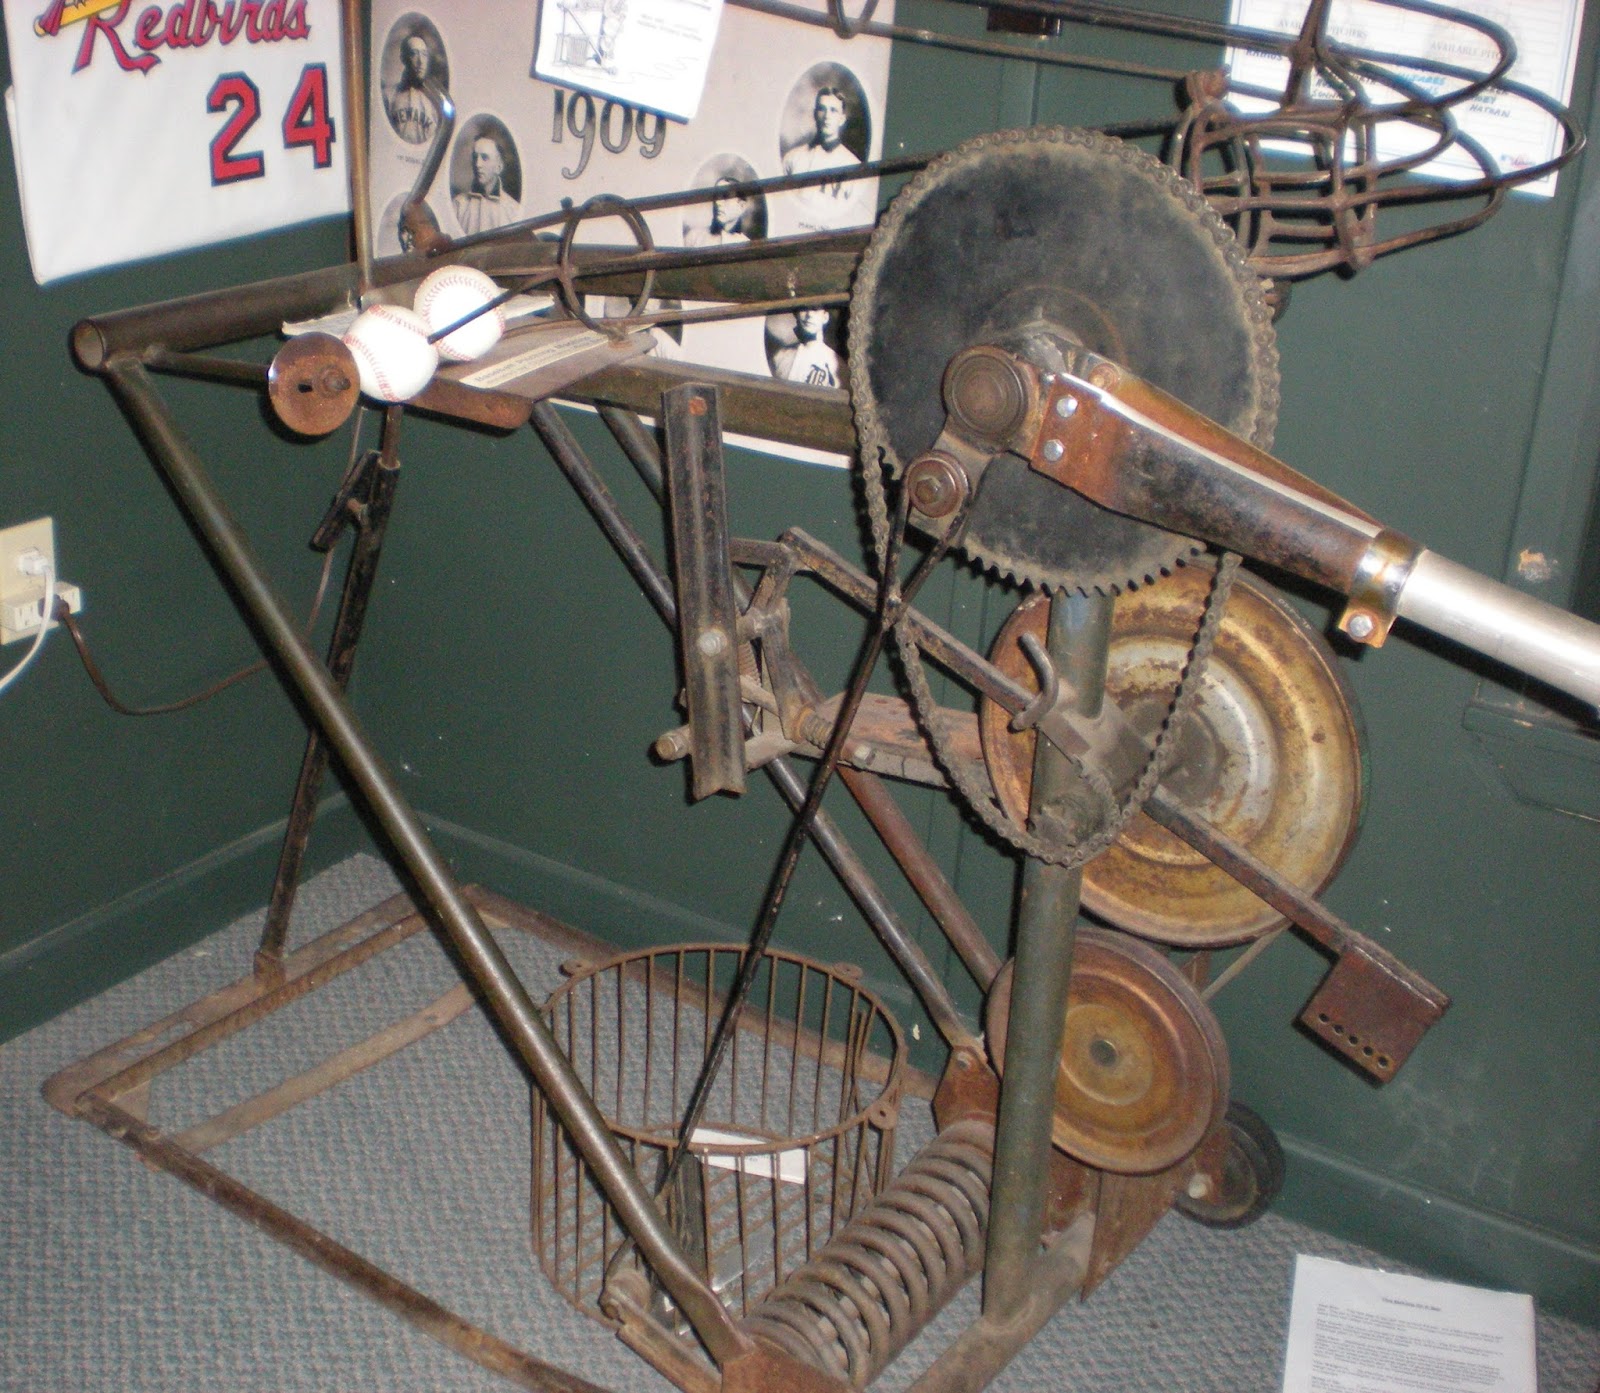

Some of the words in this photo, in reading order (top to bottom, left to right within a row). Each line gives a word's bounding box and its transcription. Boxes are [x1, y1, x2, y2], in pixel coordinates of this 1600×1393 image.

[72, 0, 312, 76] Redbirds
[206, 62, 336, 187] 24
[551, 88, 667, 180] 1909
